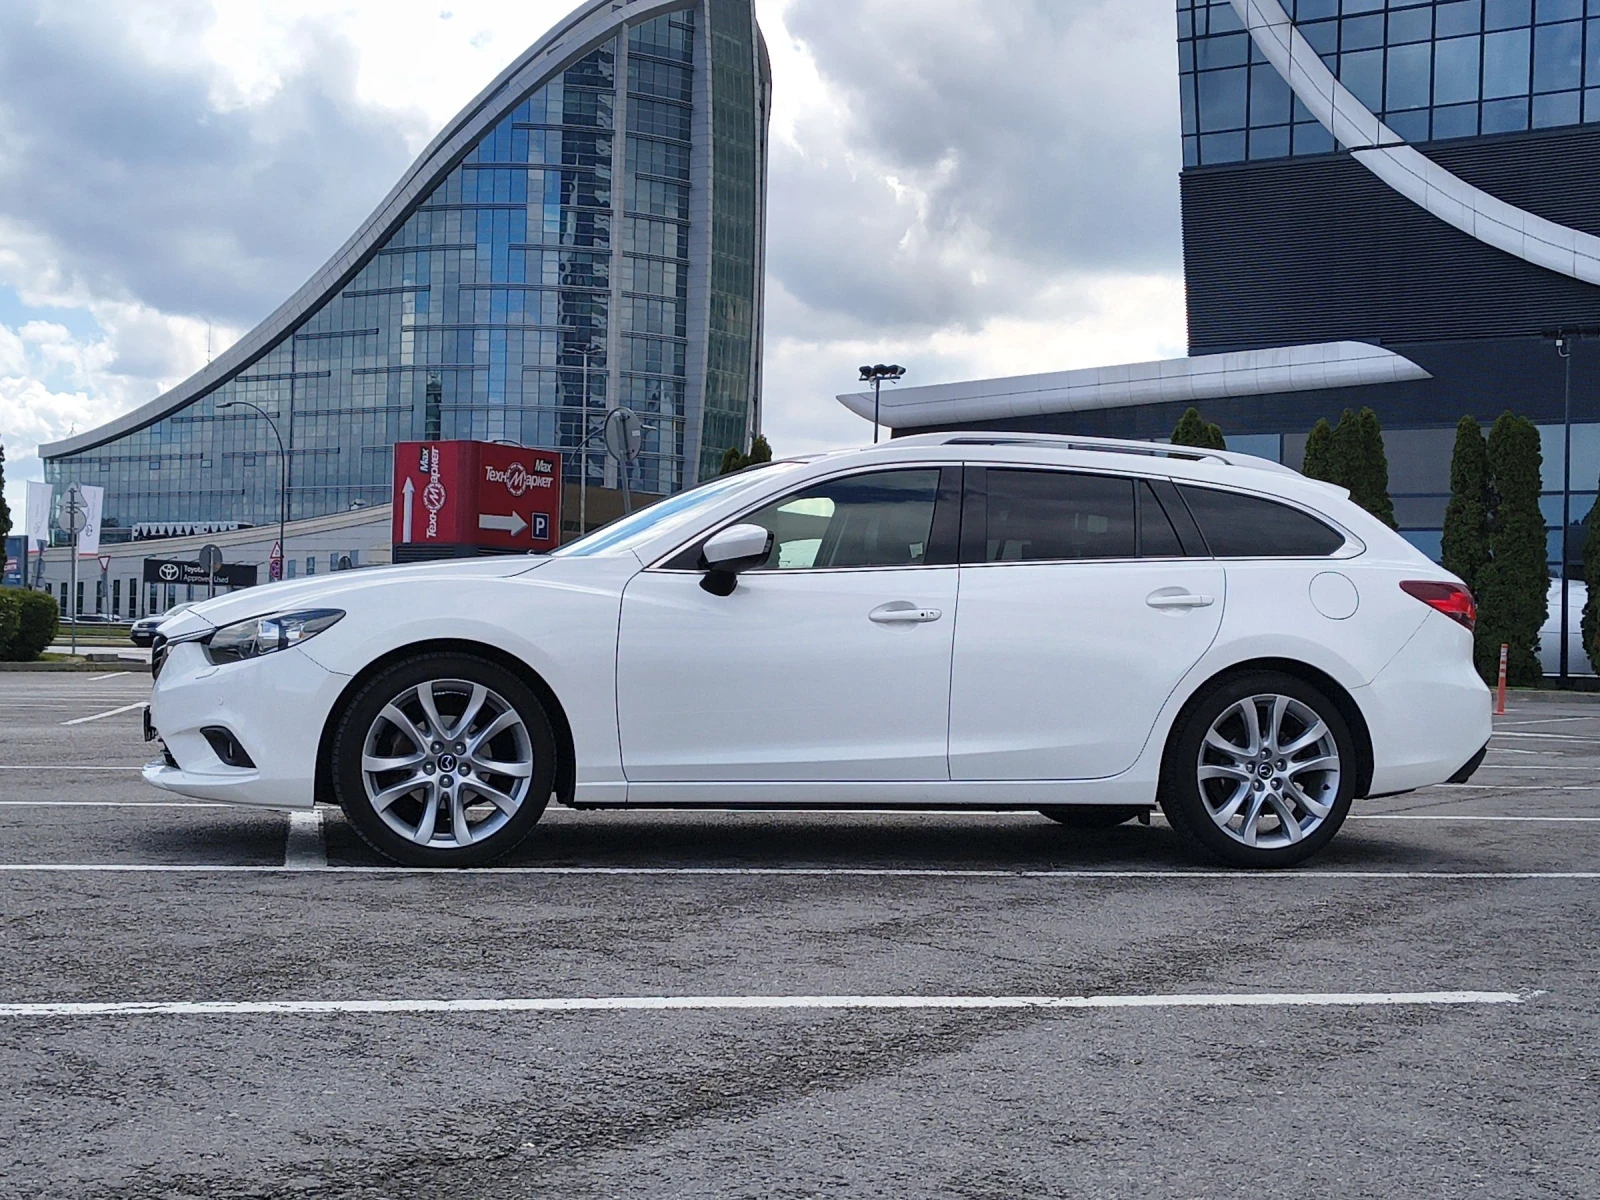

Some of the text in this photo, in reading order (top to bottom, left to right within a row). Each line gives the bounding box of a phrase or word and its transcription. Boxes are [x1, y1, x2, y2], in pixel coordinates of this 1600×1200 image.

[420, 447, 429, 471] Max
[535, 459, 553, 473] Max
[213, 575, 229, 583] Used
